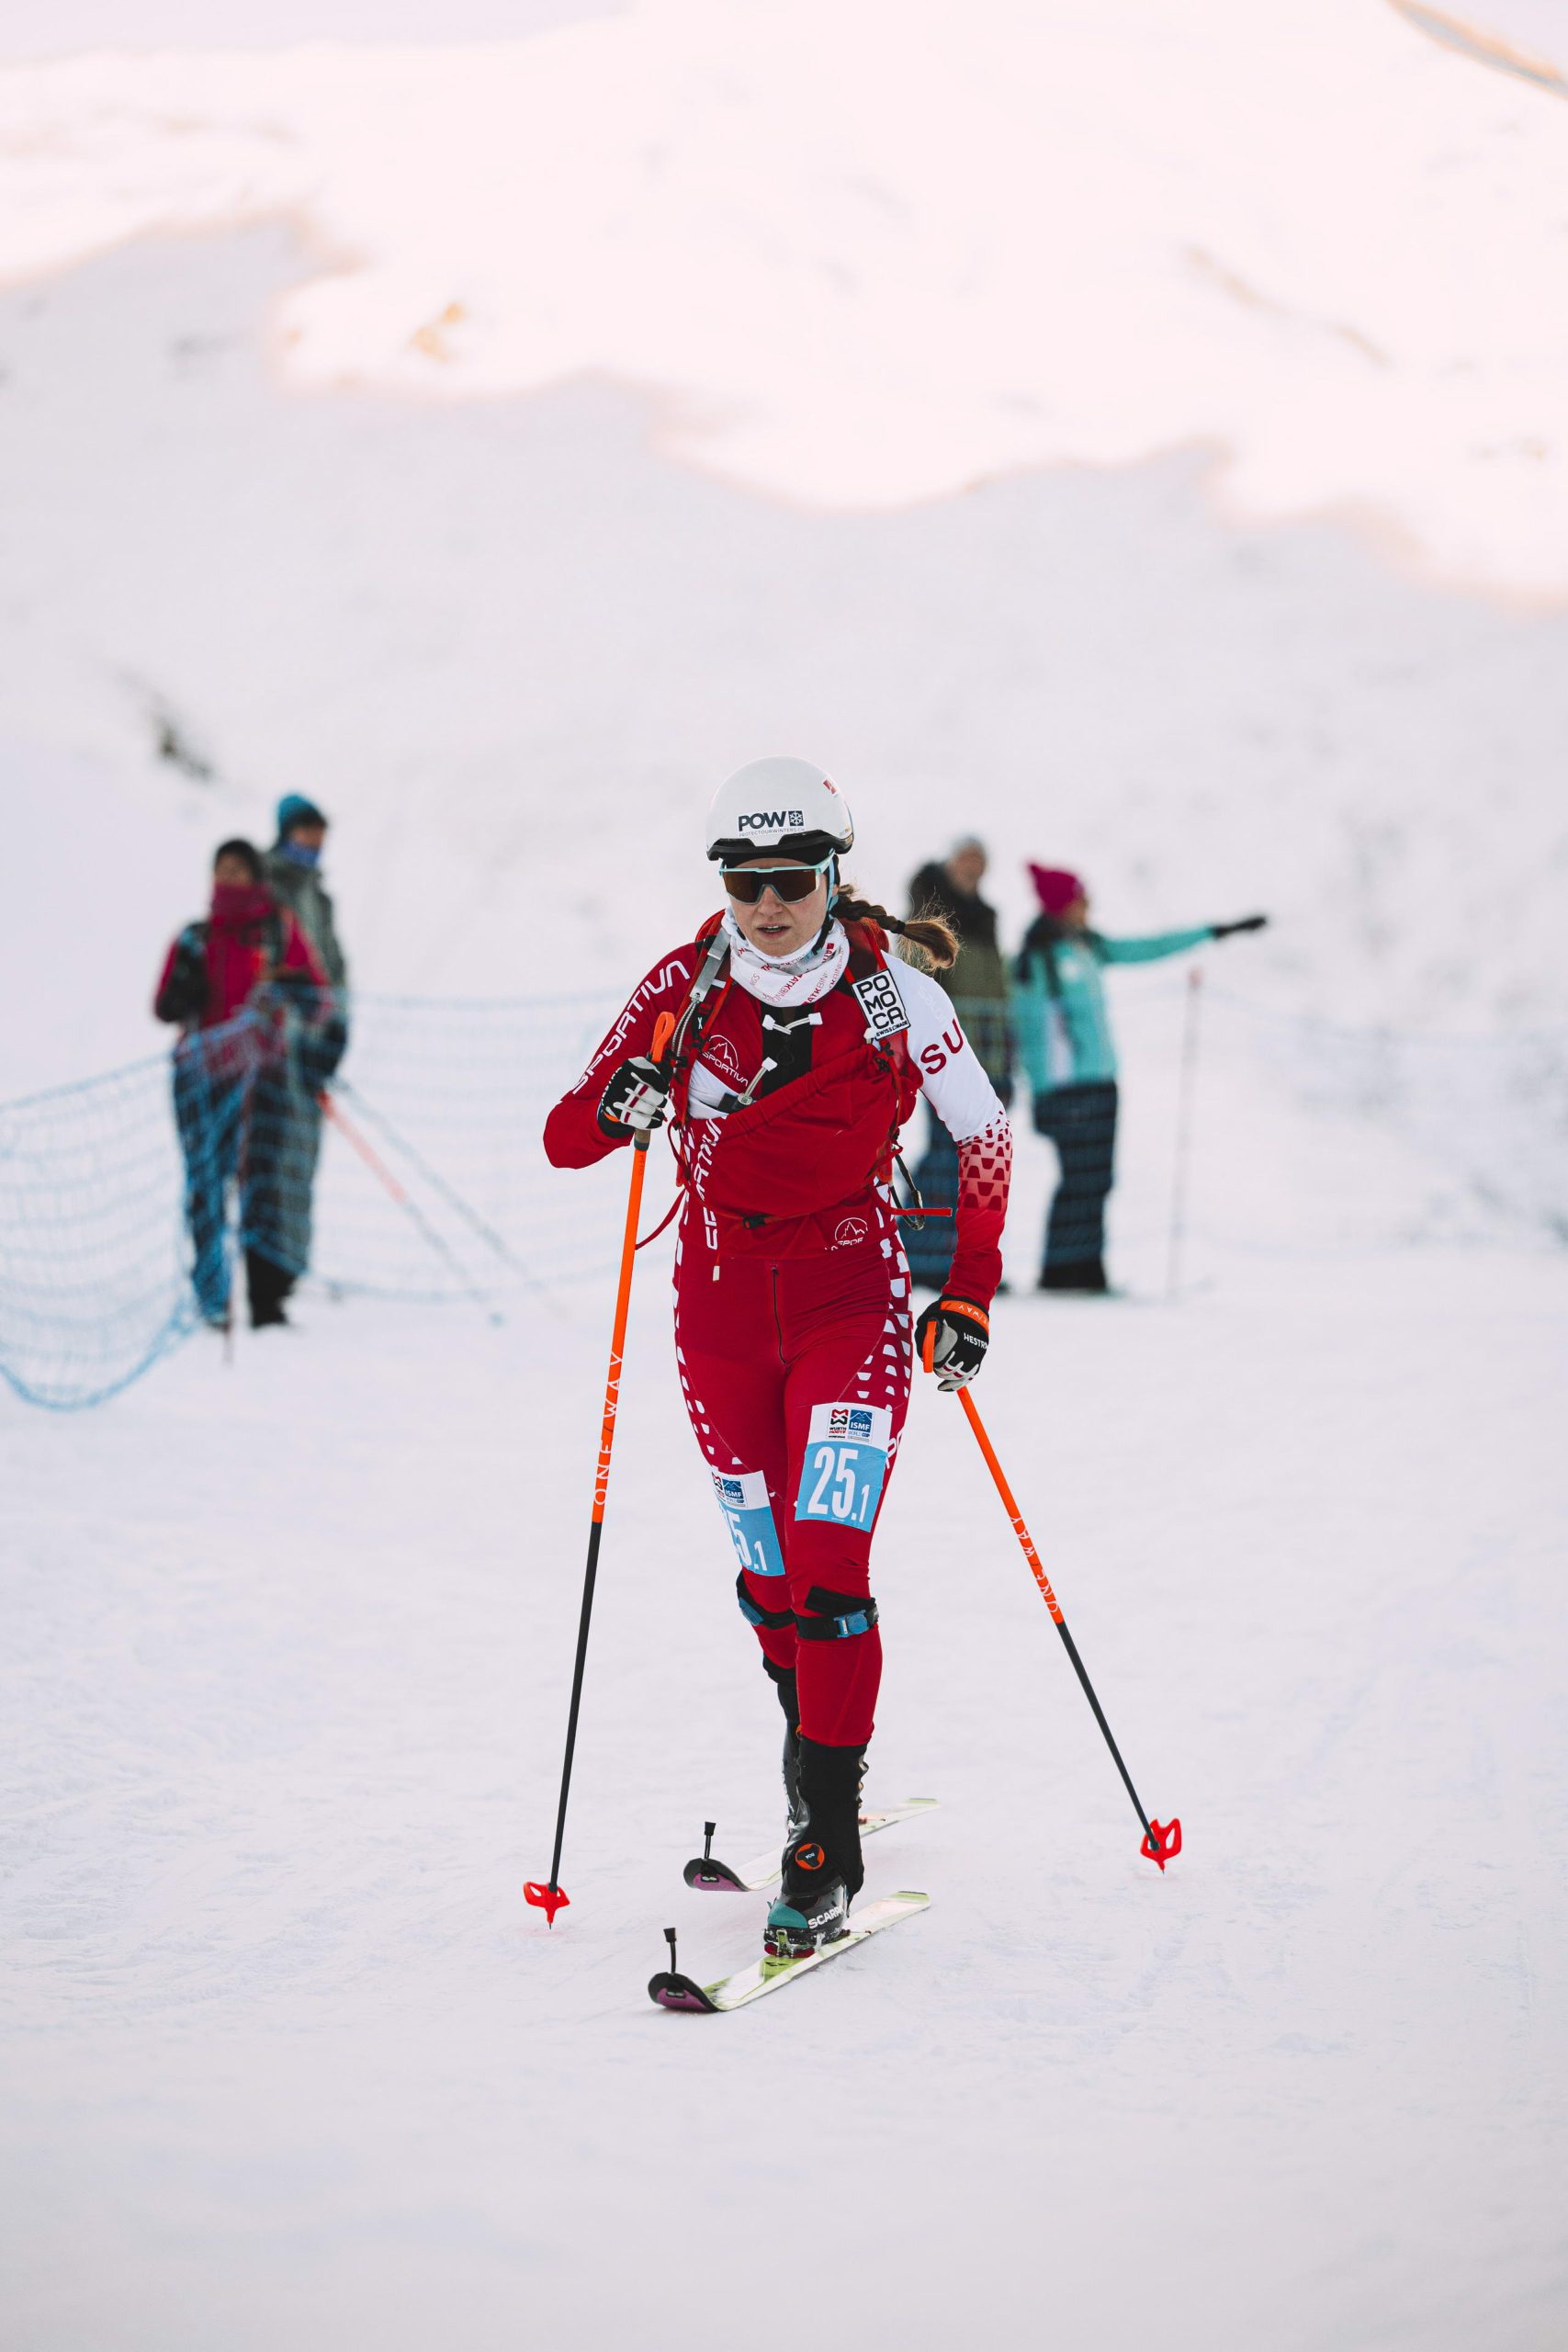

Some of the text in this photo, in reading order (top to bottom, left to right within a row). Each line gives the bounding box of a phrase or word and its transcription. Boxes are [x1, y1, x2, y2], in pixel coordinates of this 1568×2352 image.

[739, 810, 786, 831] POW
[856, 975, 890, 999] PO
[863, 989, 897, 1014] MO
[872, 1006, 904, 1029] CA
[850, 1421, 871, 1431] ISMF
[807, 1446, 870, 1523] 25.1
